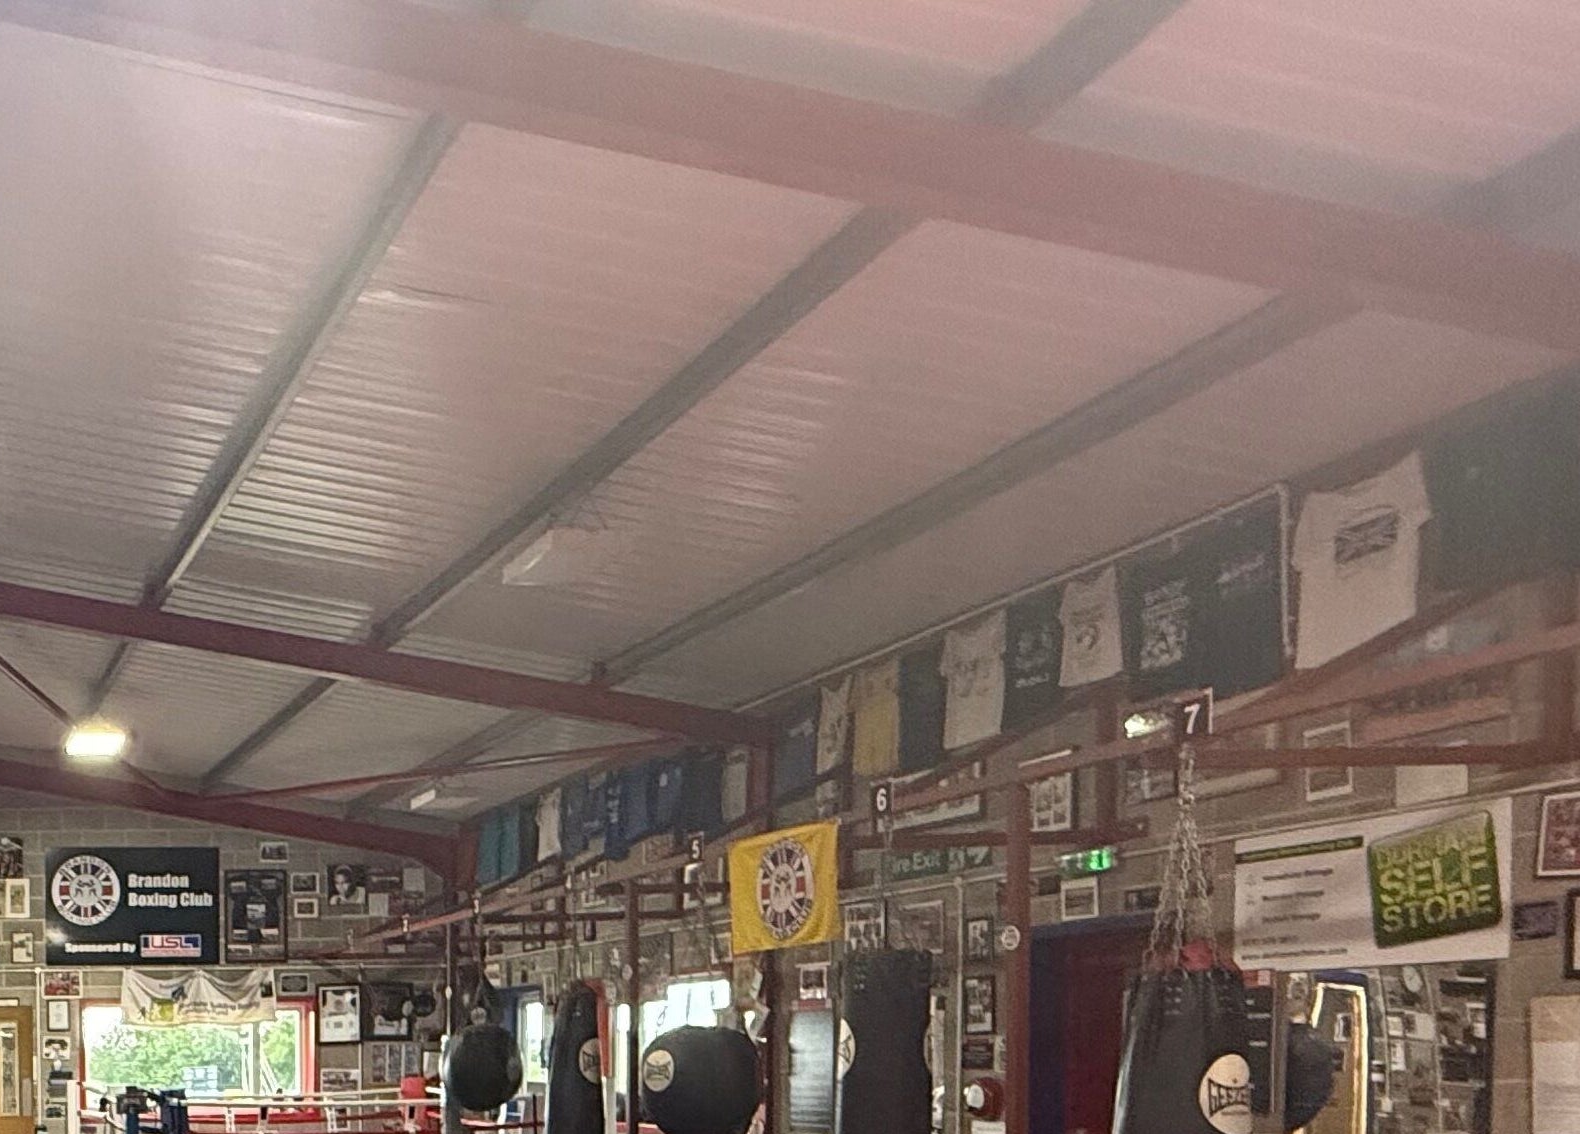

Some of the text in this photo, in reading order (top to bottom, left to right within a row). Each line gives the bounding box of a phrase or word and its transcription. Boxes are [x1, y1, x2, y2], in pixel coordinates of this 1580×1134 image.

[1184, 703, 1201, 735] 7
[876, 787, 887, 812] 6
[692, 839, 700, 859] 5
[128, 873, 189, 888] Brandon
[1379, 847, 1489, 905] SELF
[128, 892, 213, 908] Boxing Club
[1382, 884, 1494, 933] STORE
